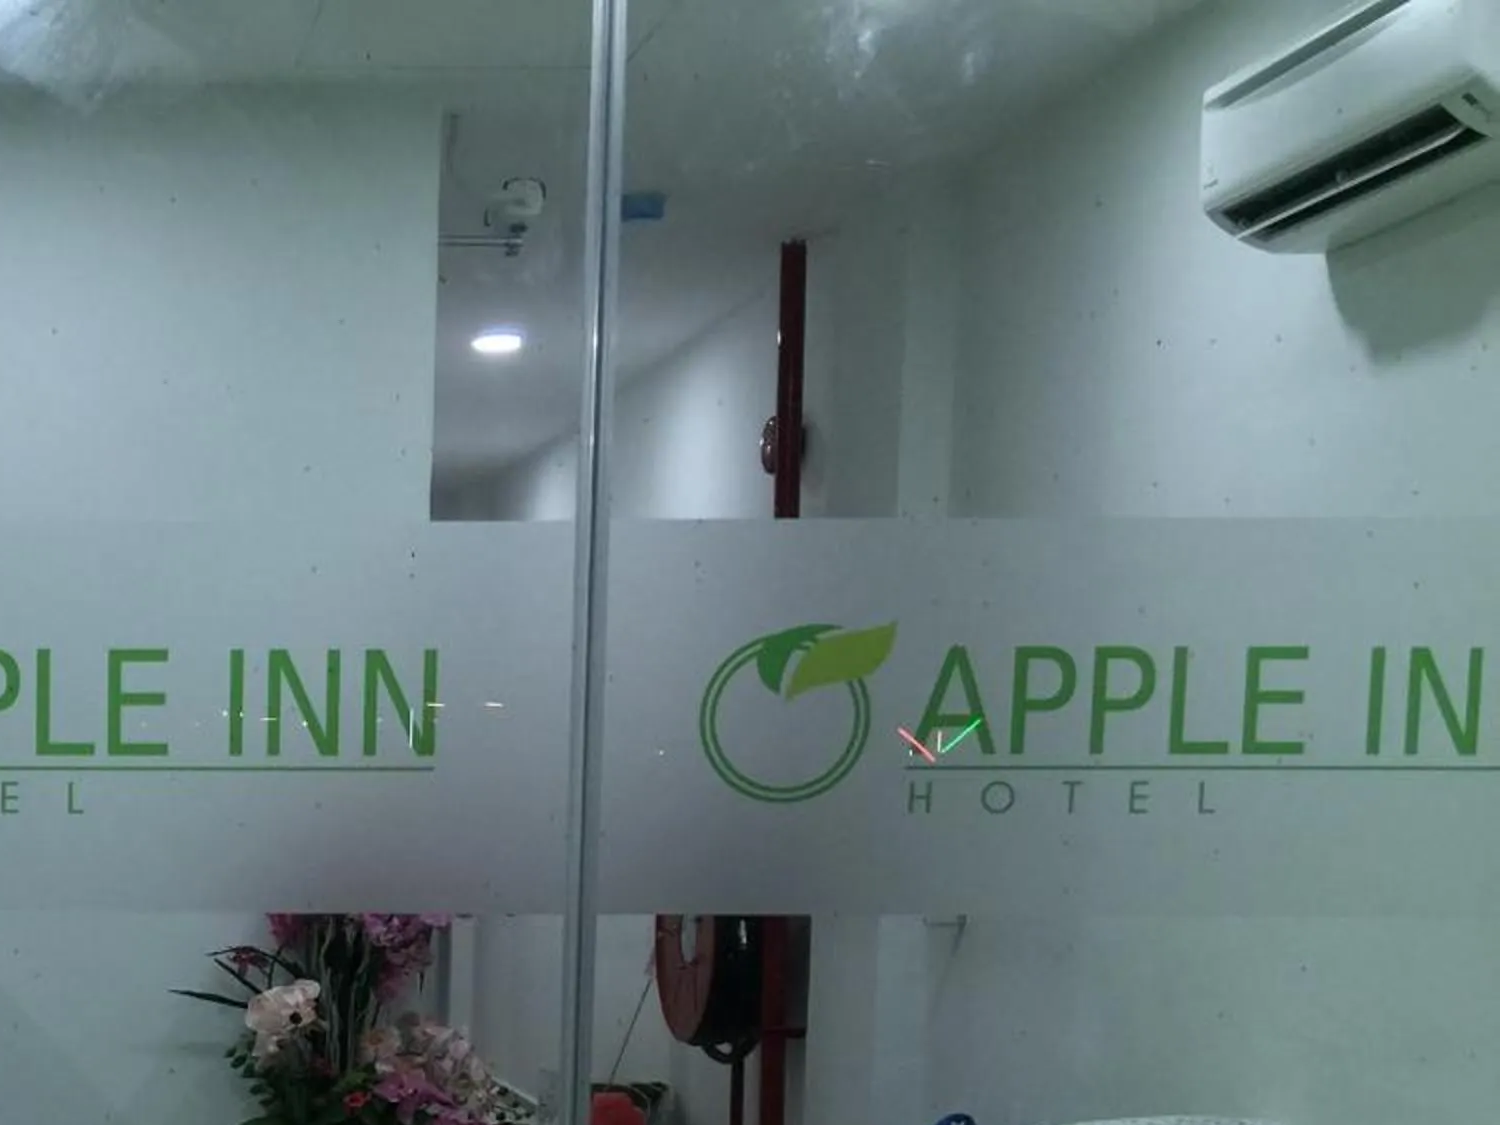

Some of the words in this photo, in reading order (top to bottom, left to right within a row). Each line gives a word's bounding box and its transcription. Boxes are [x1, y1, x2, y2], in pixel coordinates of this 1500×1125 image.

[228, 648, 440, 758] INN
[914, 645, 1310, 756] APPLE
[1365, 645, 1485, 756] IN
[907, 780, 1216, 815] HOTEL
